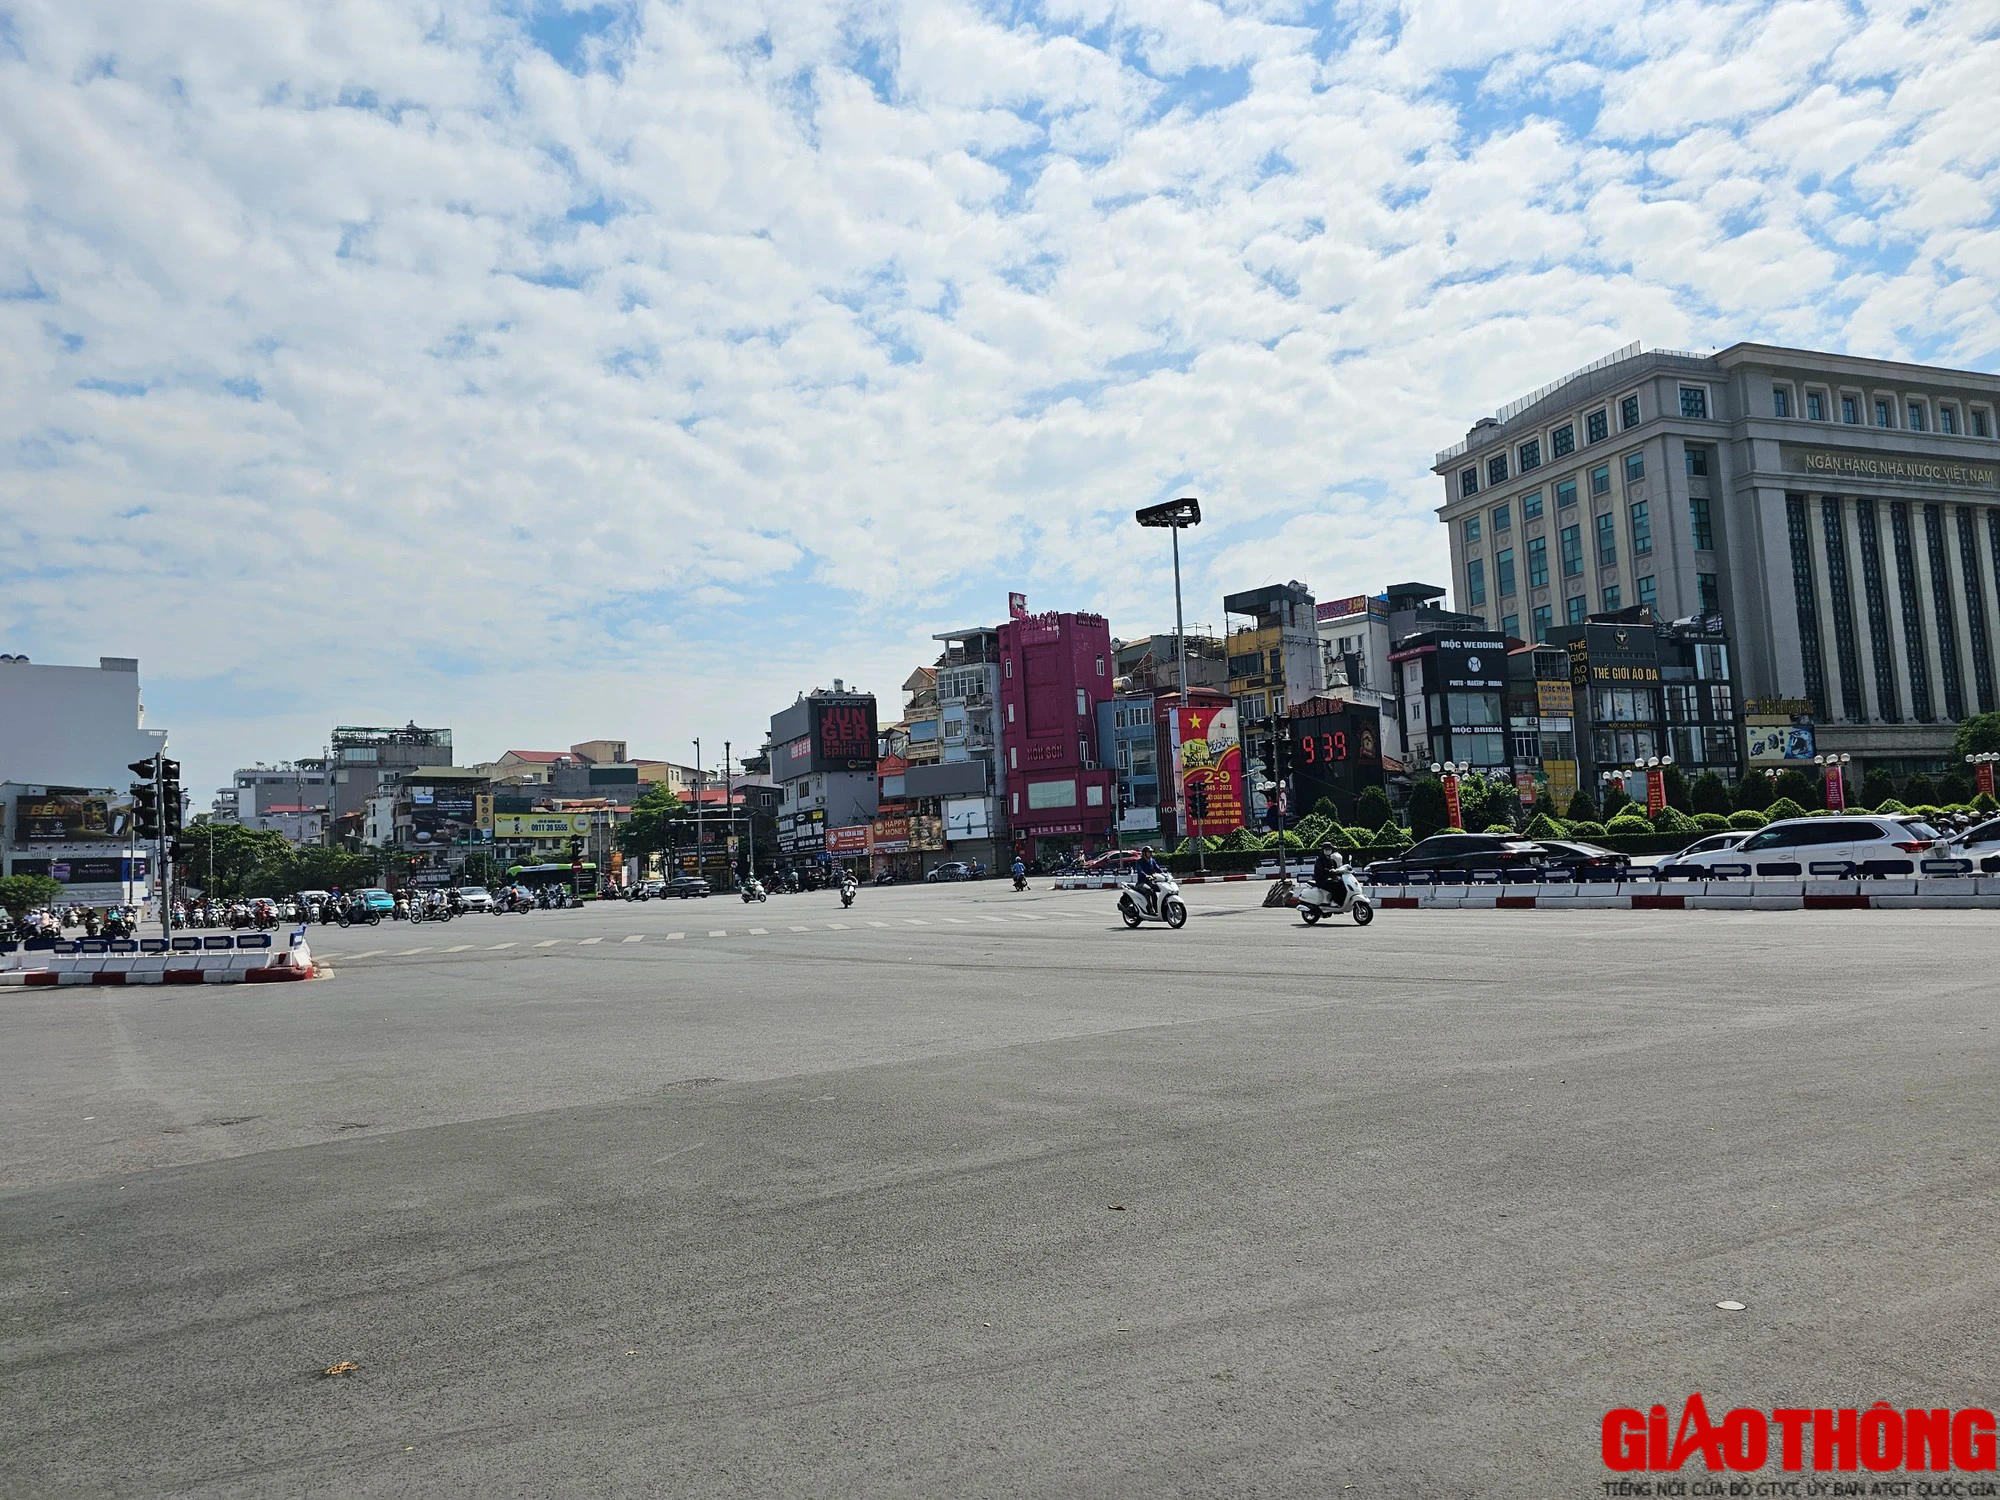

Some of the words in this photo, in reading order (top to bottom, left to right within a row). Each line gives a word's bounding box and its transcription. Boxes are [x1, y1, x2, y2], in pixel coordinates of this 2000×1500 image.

[1806, 454, 1841, 470] NGÂN
[1844, 455, 1877, 473] HÀNG
[1879, 459, 1904, 475] NHÀ
[1906, 463, 1941, 479] NƯỚC
[1943, 465, 1969, 483] VIỆT
[1970, 470, 1993, 483] NAM
[1441, 638, 1461, 650] MỘC
[1463, 641, 1504, 649] WEDDING
[1568, 636, 1586, 651] THẾ
[1570, 649, 1588, 663] GIỚI
[1593, 663, 1610, 679] THẾ
[1612, 664, 1630, 680] GIỚI
[1646, 668, 1658, 680] DA
[1575, 675, 1588, 685] DA
[822, 708, 866, 724] JUN
[822, 723, 869, 740] GER
[1452, 727, 1472, 735] MỘC
[1204, 770, 1230, 784] 2-9
[885, 820, 907, 828] HAPPY
[885, 828, 907, 836] MONEY
